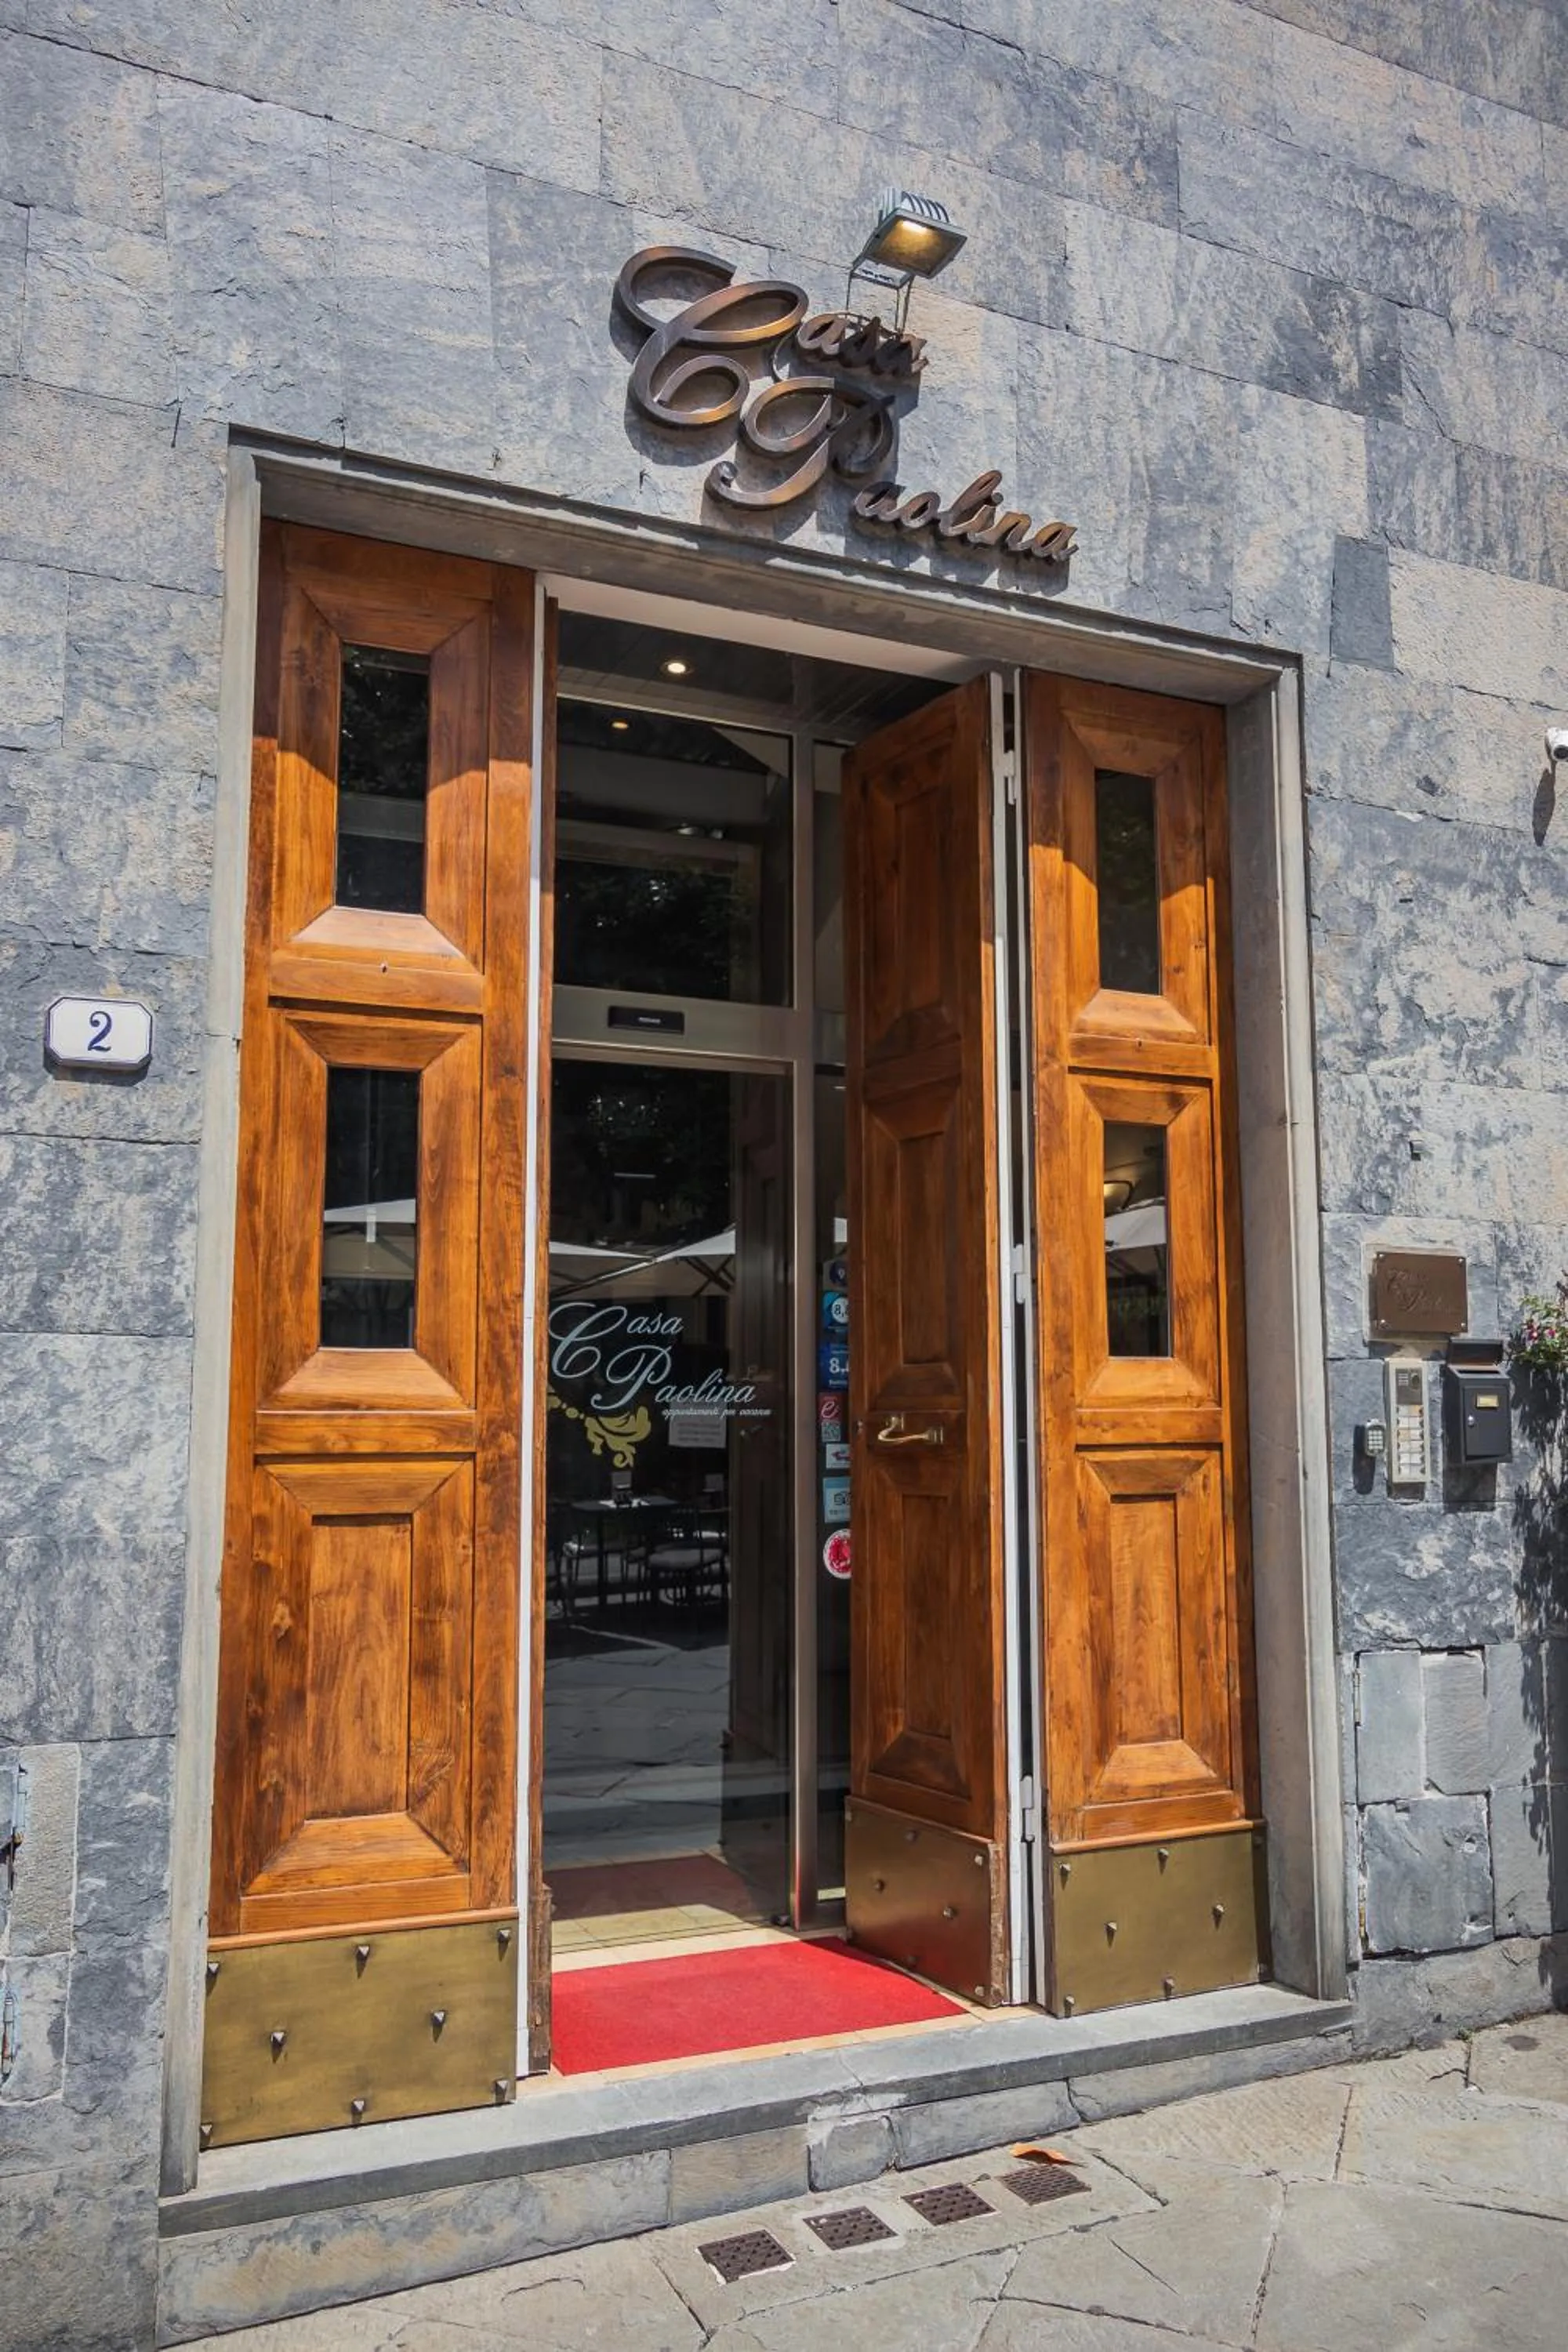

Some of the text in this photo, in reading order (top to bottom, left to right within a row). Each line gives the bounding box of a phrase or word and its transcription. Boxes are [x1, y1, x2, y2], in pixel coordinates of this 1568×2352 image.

[619, 245, 930, 427] Casa
[705, 375, 1080, 563] Paolina
[88, 1011, 112, 1052] 2
[548, 1301, 684, 1379] Casa
[590, 1344, 757, 1410] Paolina
